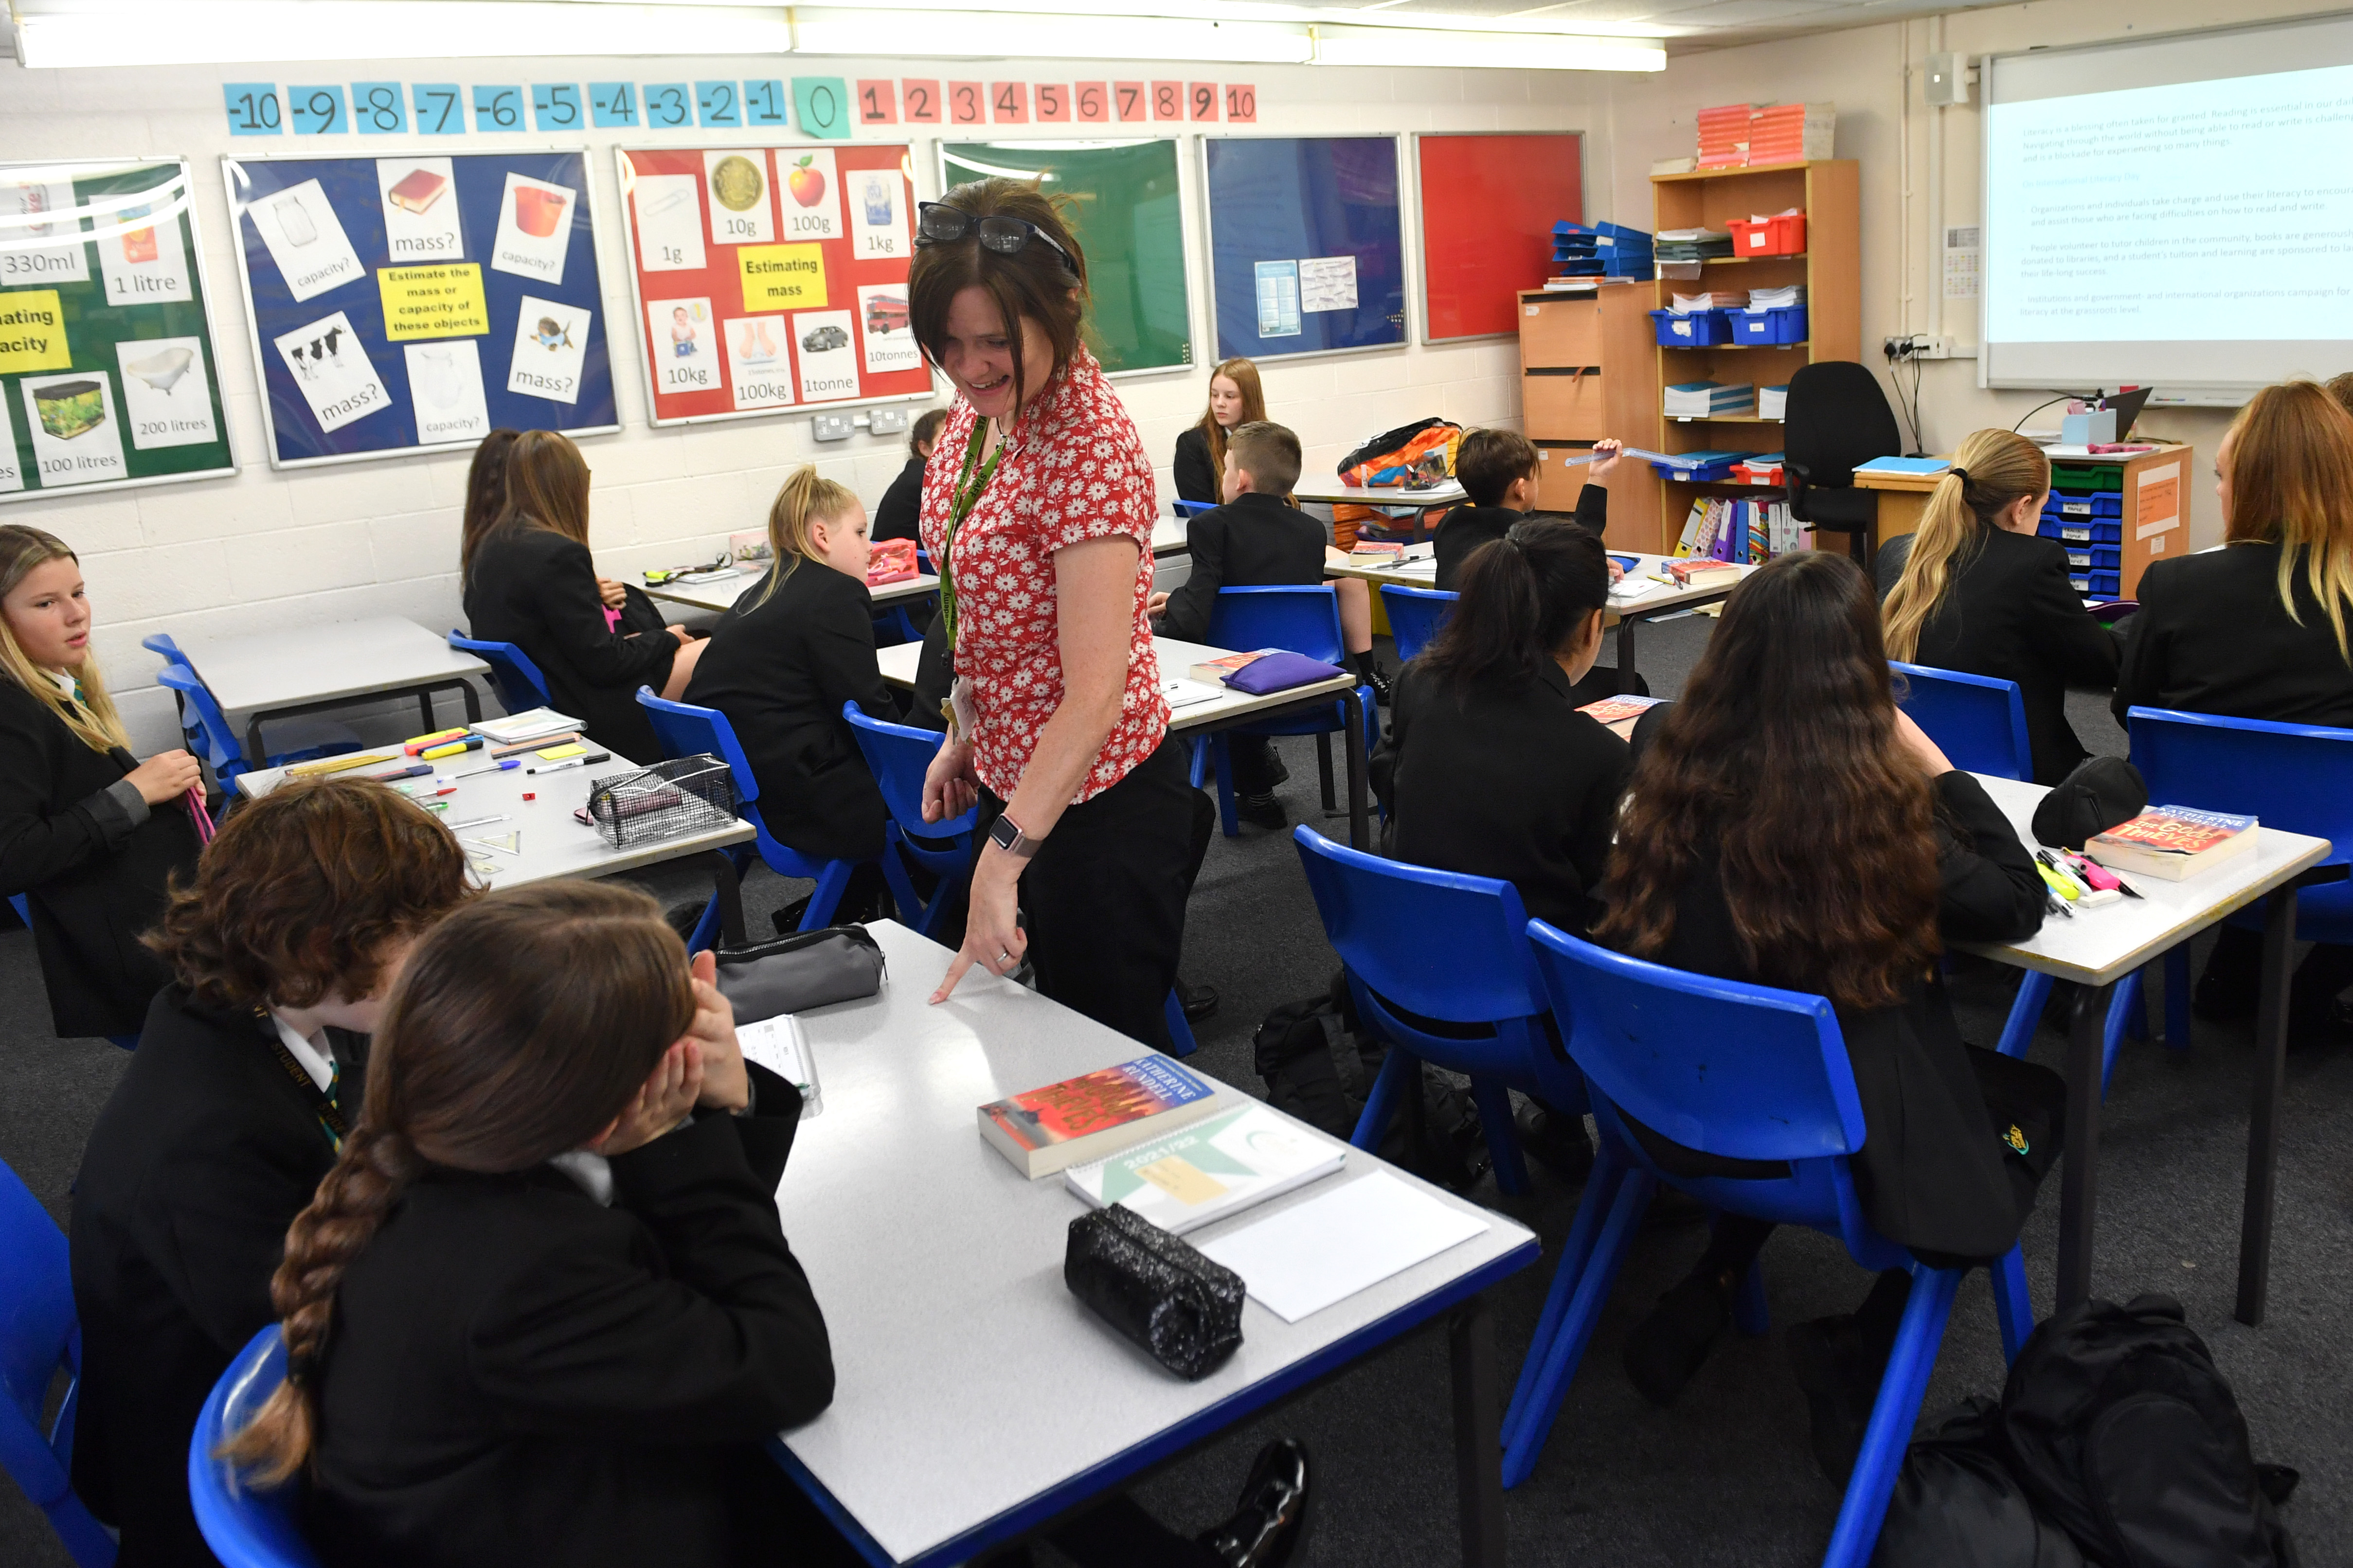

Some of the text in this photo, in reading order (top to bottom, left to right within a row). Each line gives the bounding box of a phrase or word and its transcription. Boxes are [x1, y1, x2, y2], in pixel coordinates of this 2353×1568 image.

[229, 82, 1255, 133] -10 -9 -8 -7 -6 -5 -4 -3 -2 -1 0 1 2 3 4 5 6 7 8 9 10
[727, 219, 756, 236] 10g
[793, 216, 830, 232] 100g
[395, 232, 455, 252] mass?
[868, 234, 893, 252] 1kg
[4, 251, 75, 273] 330ml
[502, 249, 556, 269] capacity?
[663, 246, 682, 264] 1g
[298, 257, 349, 286] capacity?
[389, 267, 470, 281] Estimate the
[746, 259, 818, 274] Estimating
[116, 274, 176, 294] 1 litre
[407, 288, 440, 297] mass
[767, 285, 802, 297] mass
[0, 309, 54, 325] ating
[399, 301, 469, 315] capacity of
[394, 318, 480, 332] these objects
[869, 350, 918, 363] 10tonnes
[516, 370, 574, 393] mass?
[668, 367, 707, 387] 10kg
[805, 377, 853, 393] 1tonne
[739, 383, 786, 401] 100kg
[322, 384, 378, 422] mass?
[140, 418, 207, 435] 200 litres
[426, 416, 480, 433] capacity?
[977, 416, 987, 431] STA
[42, 456, 117, 473] 100 litres
[958, 452, 974, 489] Academy
[970, 472, 987, 498] STAFF
[2159, 807, 2245, 827] KATHERINE
[2160, 812, 2227, 829] RUNDELL
[2115, 824, 2207, 849] THIEVES
[2135, 820, 2213, 839] THE GOOD
[271, 1043, 311, 1087] STUDENT
[1122, 1065, 1172, 1101] RUNDELL
[1134, 1058, 1197, 1101] KATHERINE
[1124, 1135, 1200, 1169] 2021/22
